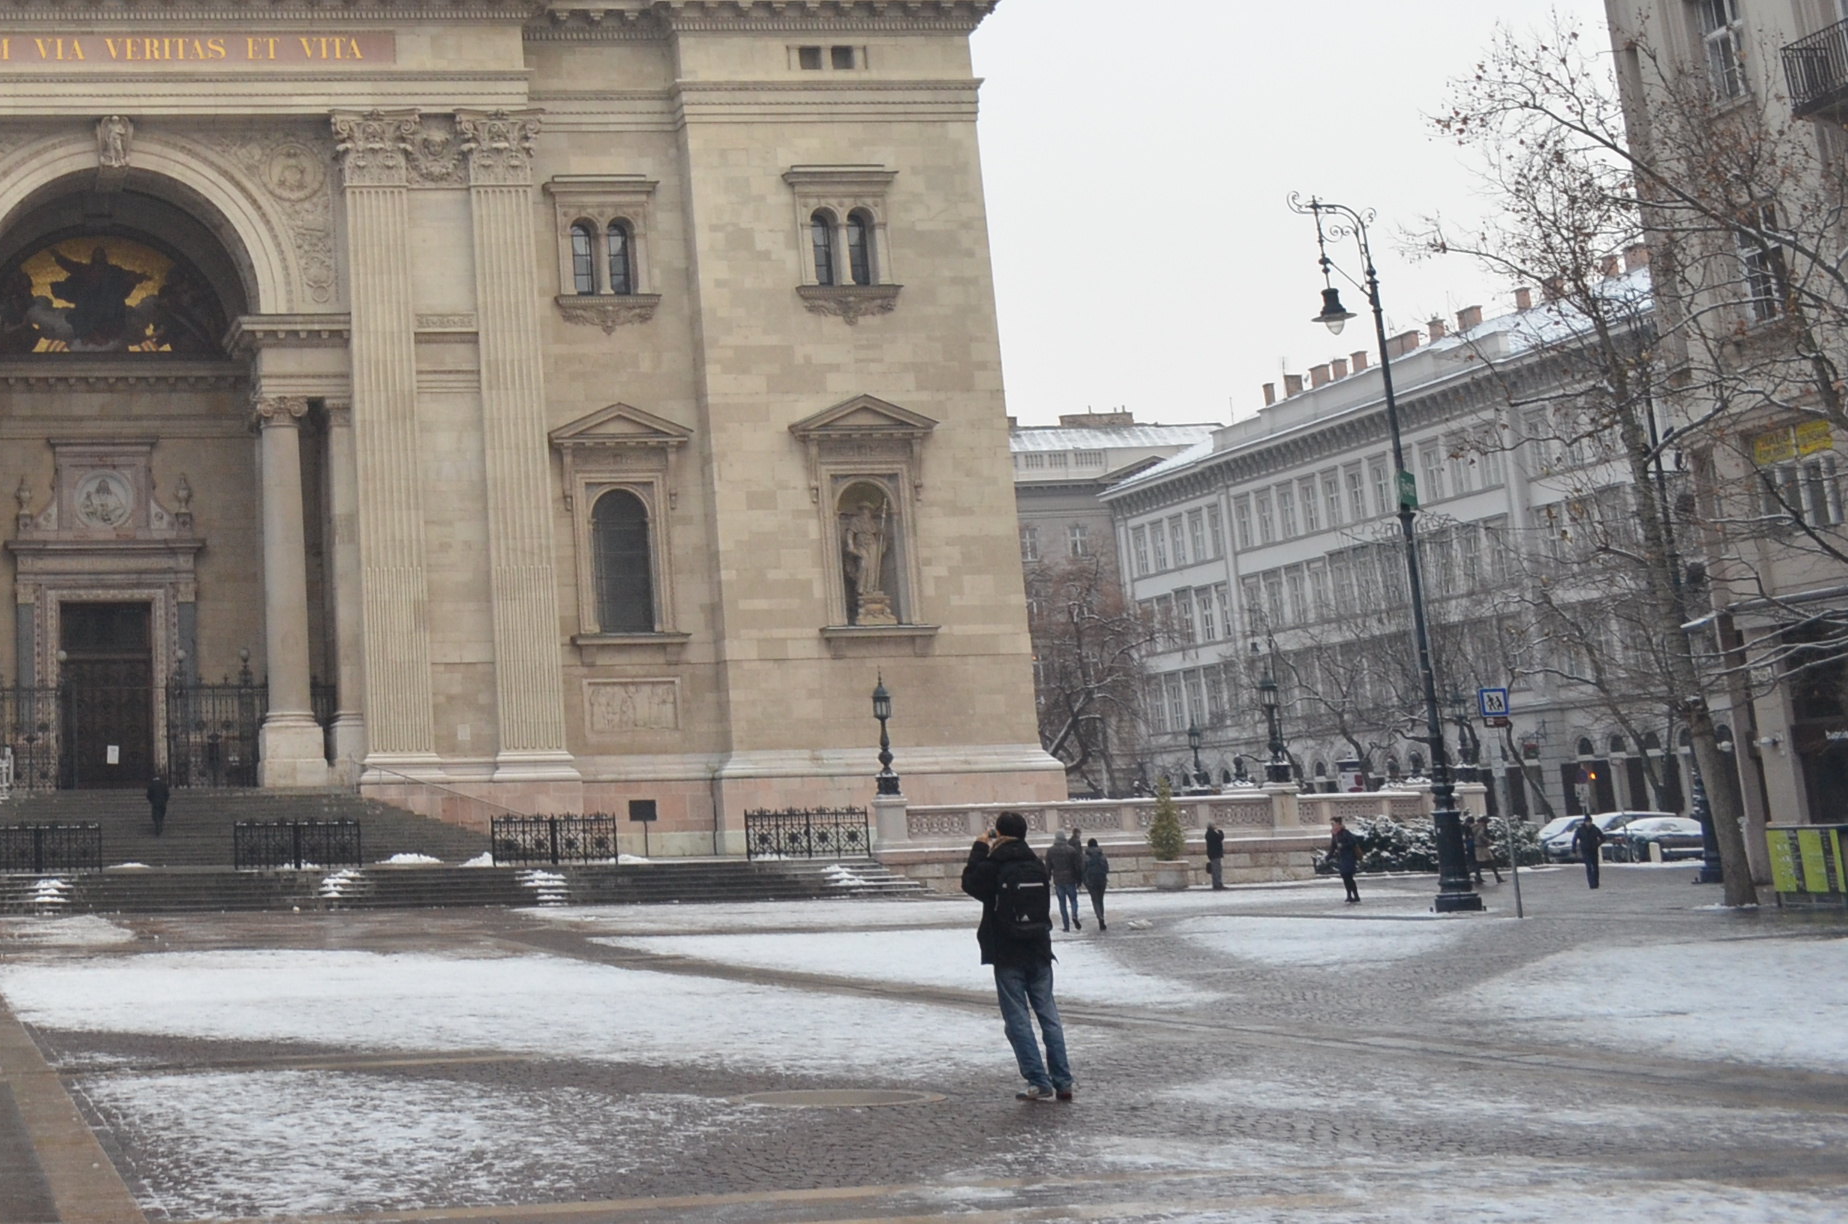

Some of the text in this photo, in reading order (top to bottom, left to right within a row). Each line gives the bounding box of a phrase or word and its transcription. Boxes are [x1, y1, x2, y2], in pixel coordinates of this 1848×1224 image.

[33, 38, 86, 61] VIA
[105, 37, 227, 61] VERITAS
[246, 37, 280, 60] ET
[299, 37, 364, 60] VITA
